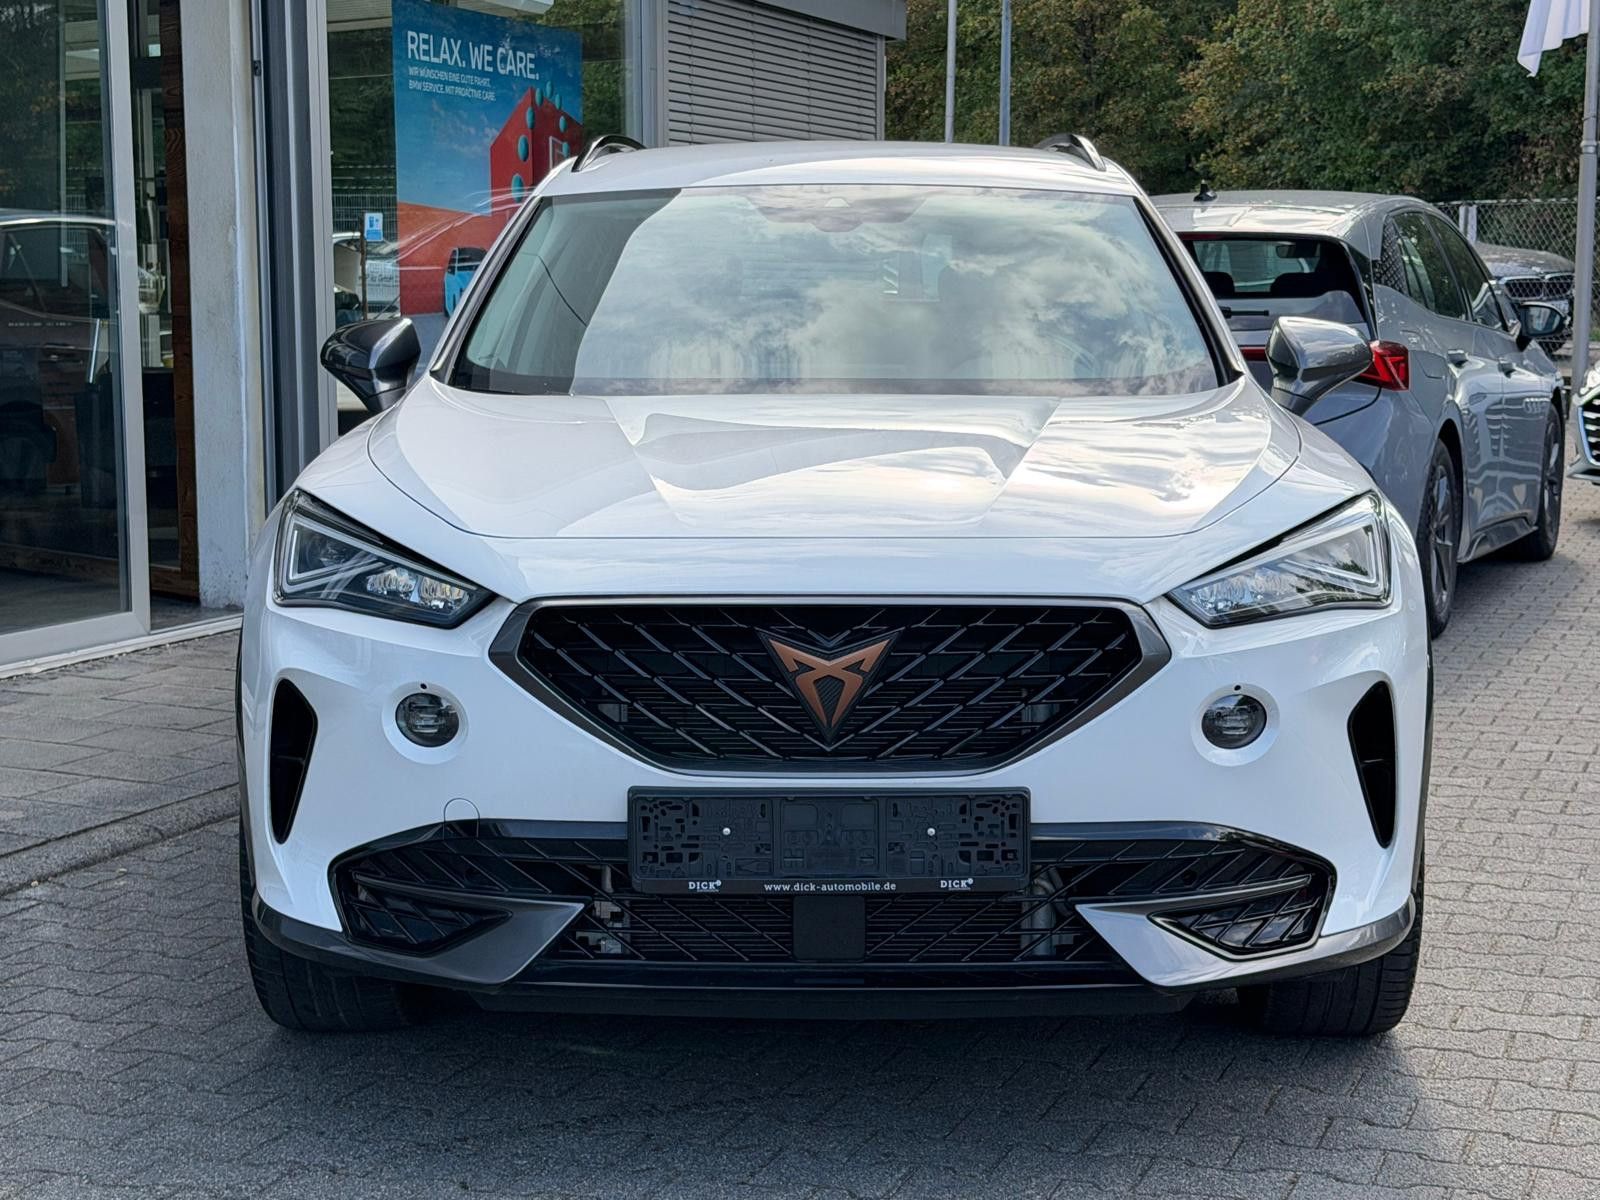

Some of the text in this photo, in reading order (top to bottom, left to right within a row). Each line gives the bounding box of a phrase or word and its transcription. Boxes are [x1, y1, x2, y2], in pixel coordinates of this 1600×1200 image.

[407, 30, 539, 80] RELAX. WE CARE.
[449, 72, 460, 83] EINE
[408, 79, 421, 90] BMW
[445, 85, 455, 95] MIT
[455, 86, 482, 99] PROACTIVE
[688, 881, 716, 890] DICK
[763, 881, 897, 892] www.dick-automobile.de
[940, 879, 967, 888] DICK
